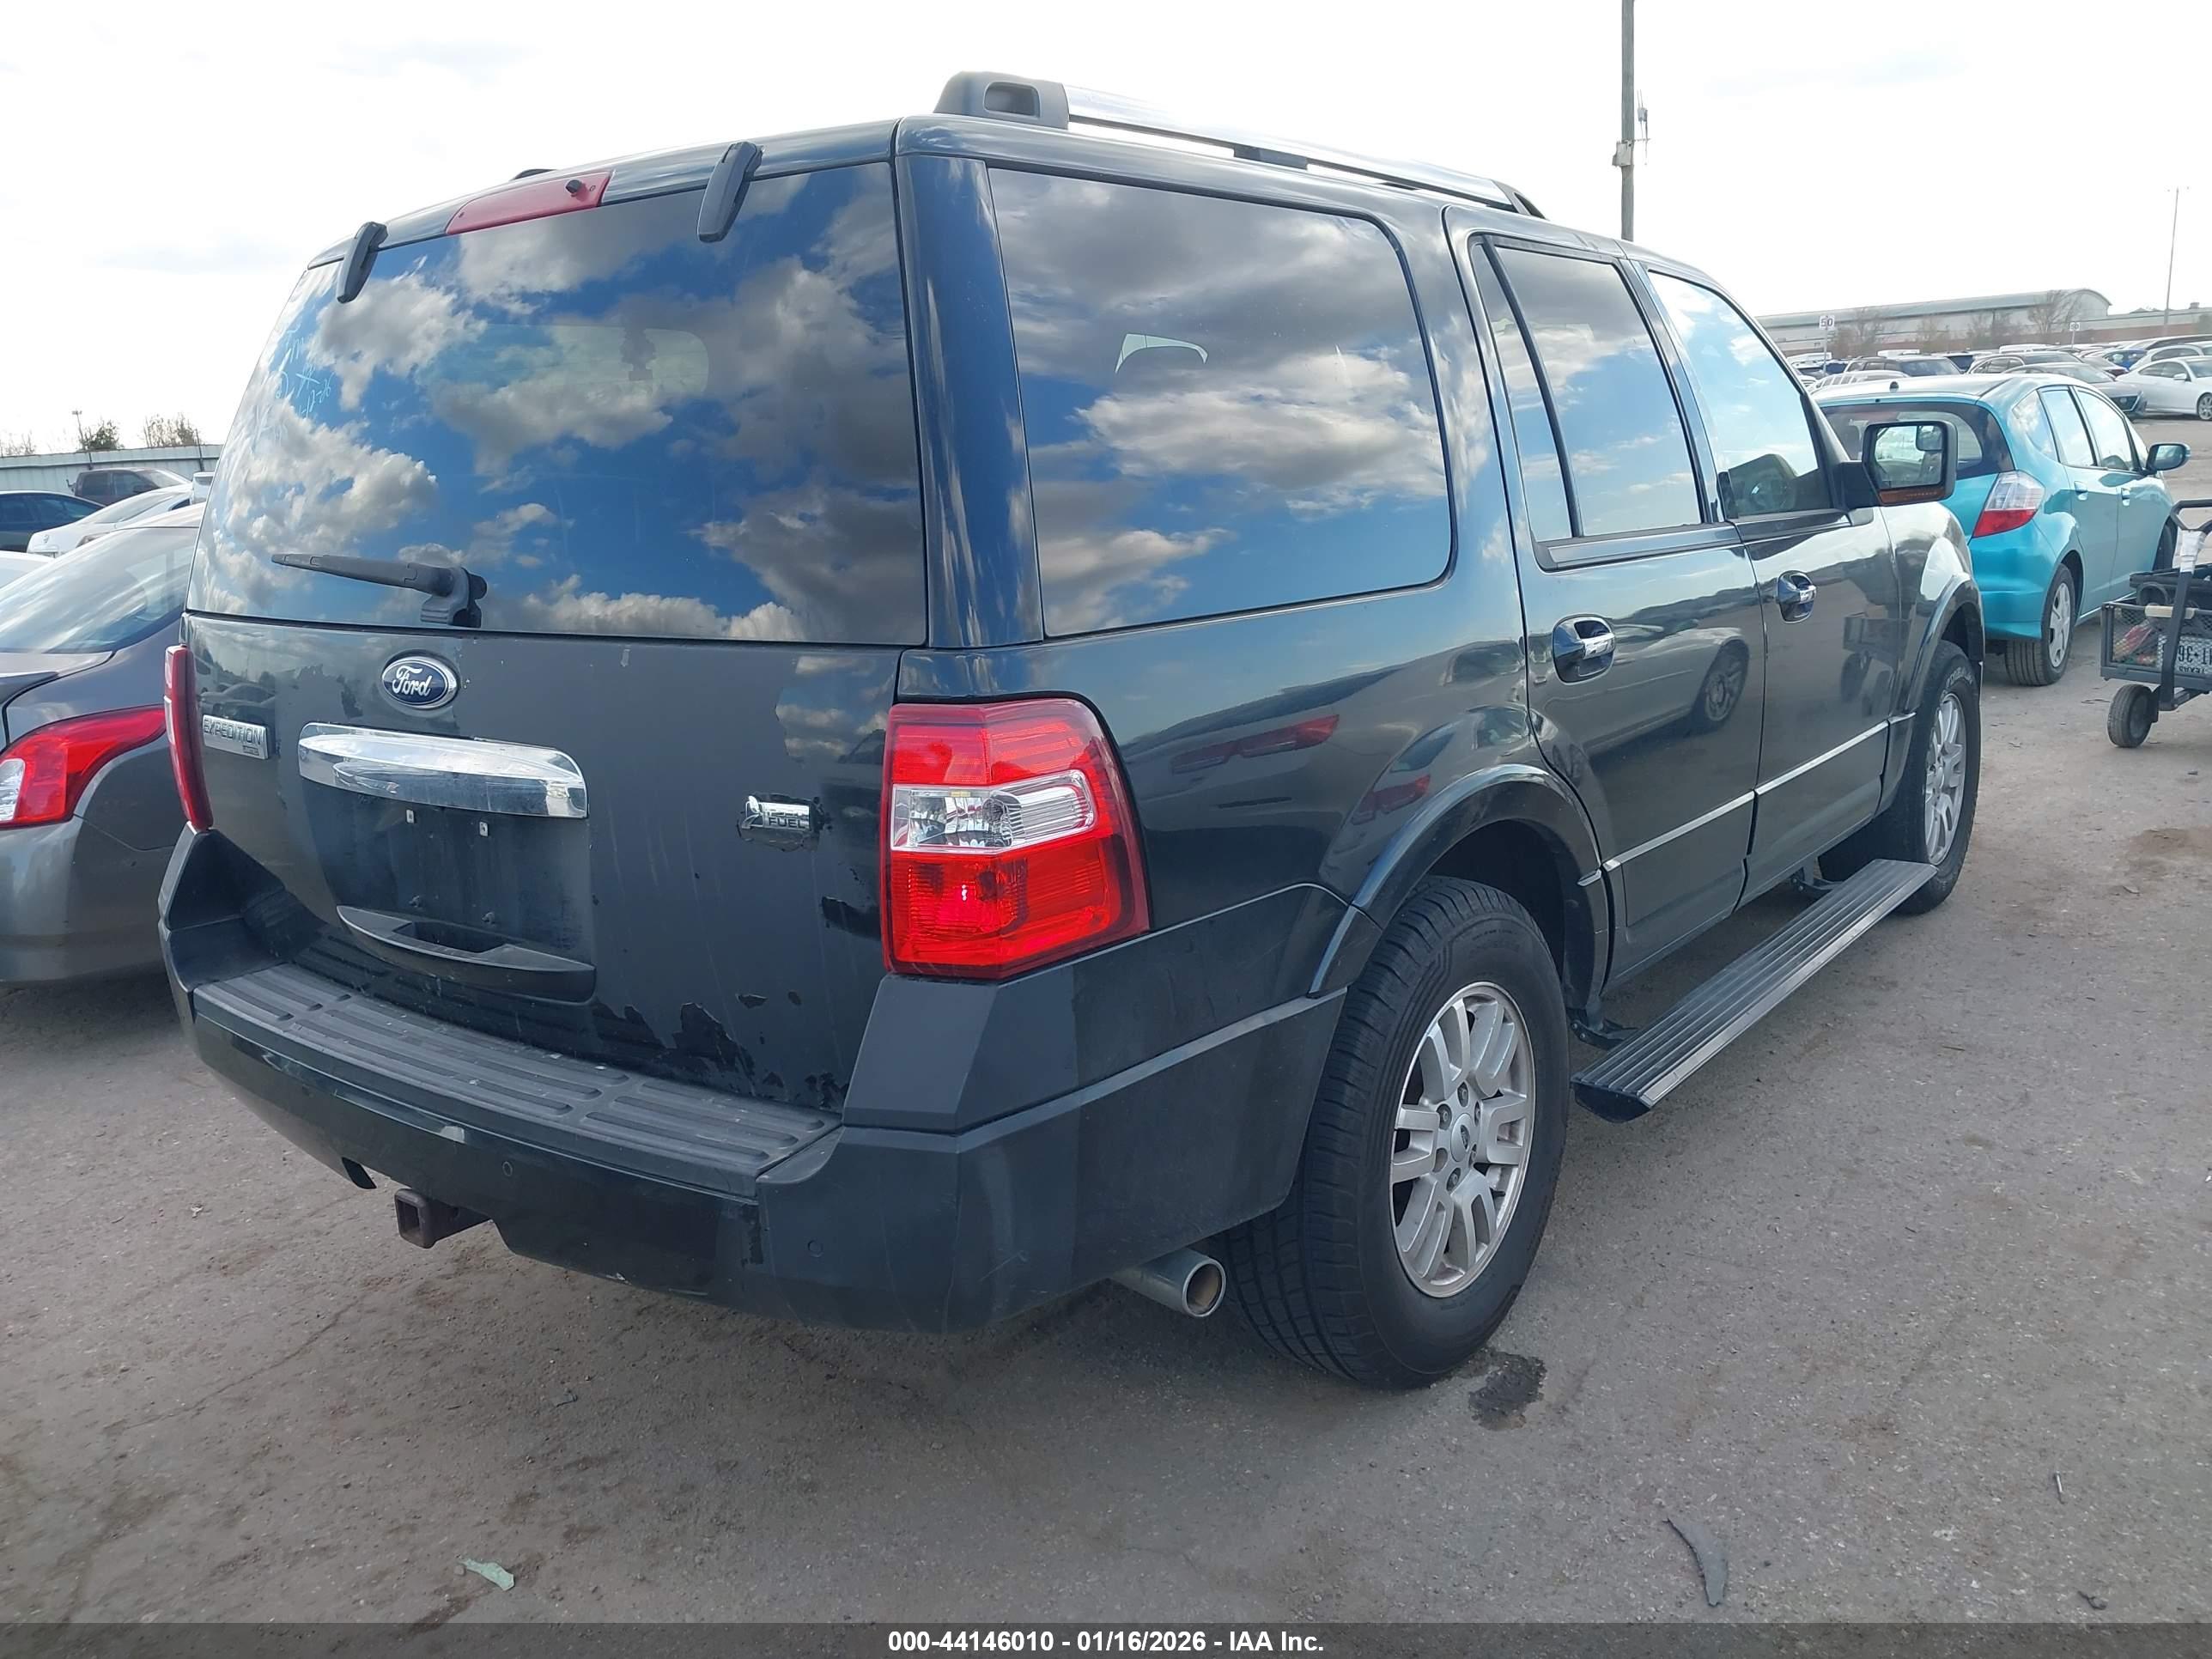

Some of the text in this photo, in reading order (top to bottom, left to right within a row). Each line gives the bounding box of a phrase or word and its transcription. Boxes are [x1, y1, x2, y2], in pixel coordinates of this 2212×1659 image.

[392, 665, 433, 696] Ford
[204, 718, 264, 746] EXPEDITION
[769, 817, 806, 829] FUEL
